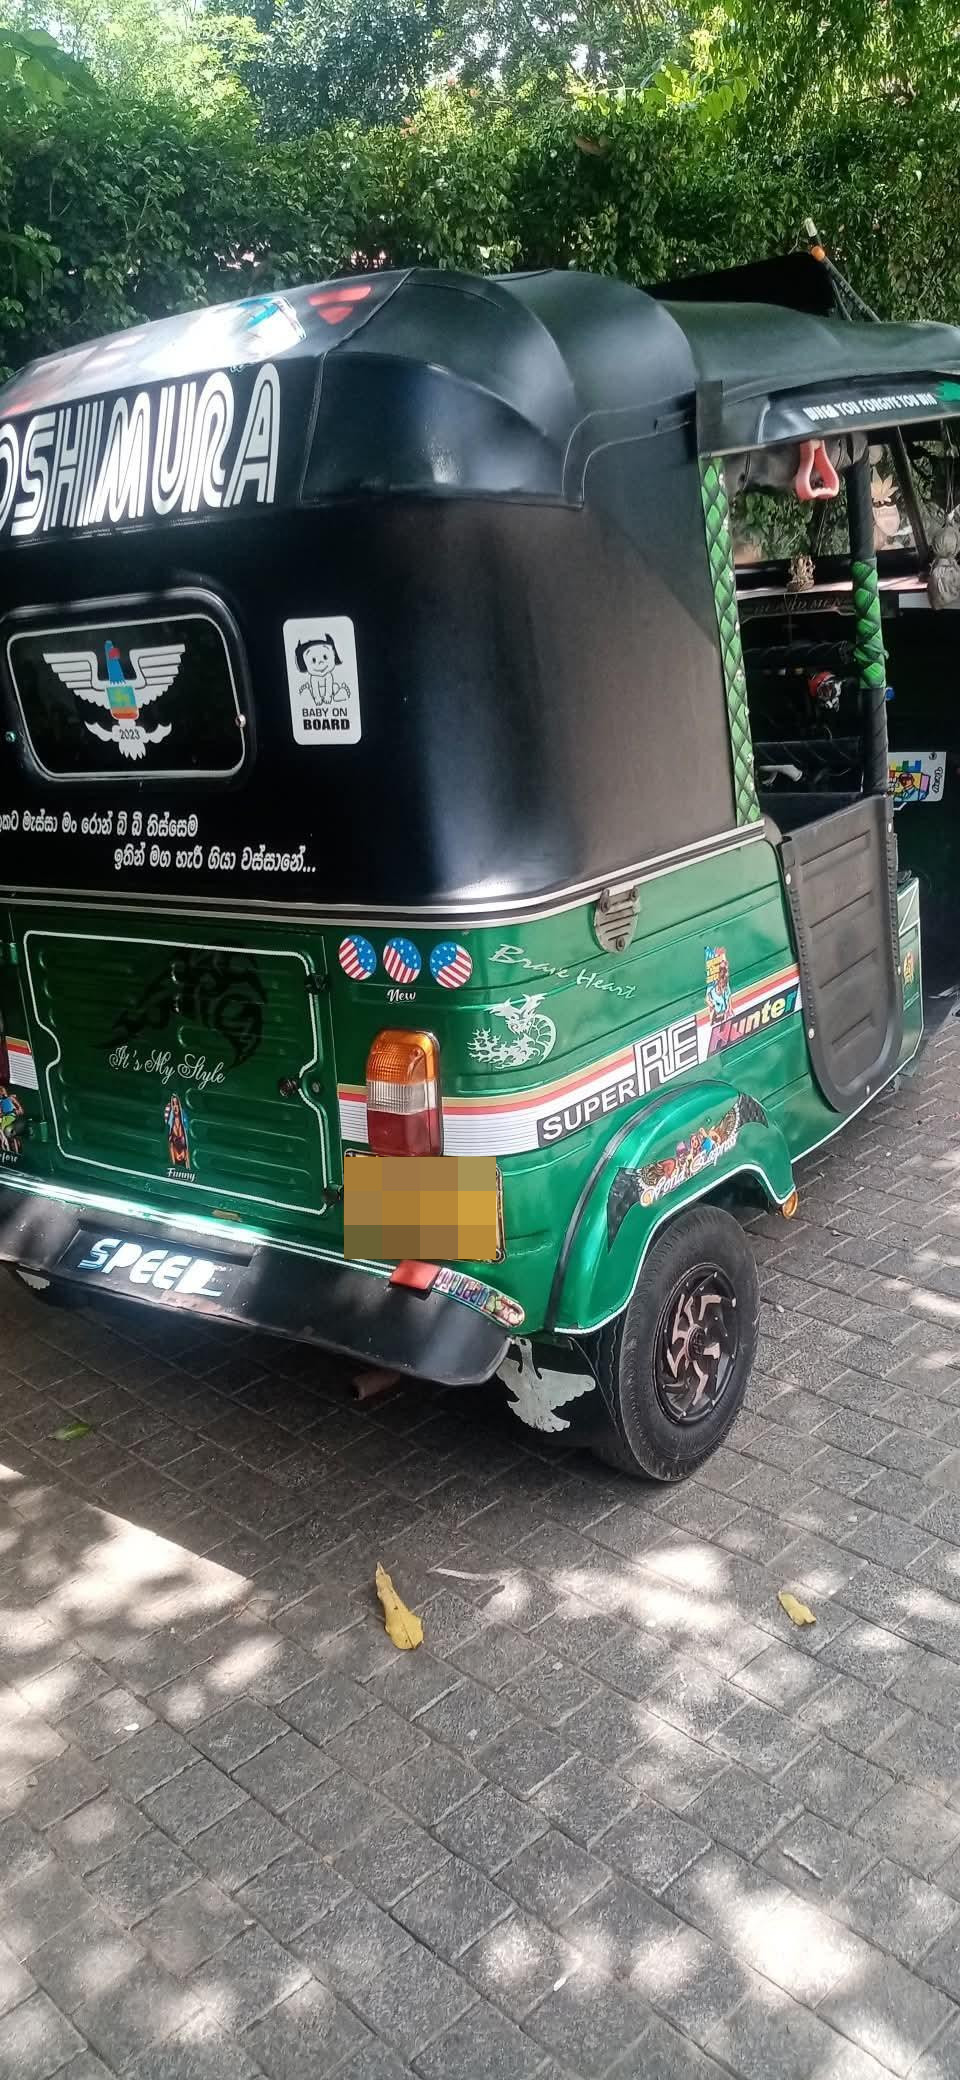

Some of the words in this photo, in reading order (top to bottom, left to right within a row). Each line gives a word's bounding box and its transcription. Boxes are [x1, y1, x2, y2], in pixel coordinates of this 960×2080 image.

[834, 401, 861, 416] YOU
[896, 394, 921, 408] YOU
[302, 707, 329, 717] BABY
[332, 707, 348, 717] ON
[119, 728, 141, 741] 2023
[303, 718, 350, 731] BOARD
[22, 808, 58, 832] මැස්සා
[62, 811, 77, 833] මං
[81, 811, 113, 835] රොන්
[149, 845, 171, 868] මග
[207, 846, 236, 871] ගියා
[488, 943, 569, 978] Brave
[576, 968, 636, 999] Heart
[387, 989, 417, 1002] New
[109, 1045, 142, 1071] It's
[145, 1049, 175, 1085] My
[177, 1053, 226, 1090] Style
[543, 1080, 637, 1141] SUPER
[634, 1015, 700, 1096] RE
[708, 987, 799, 1051] Hunter
